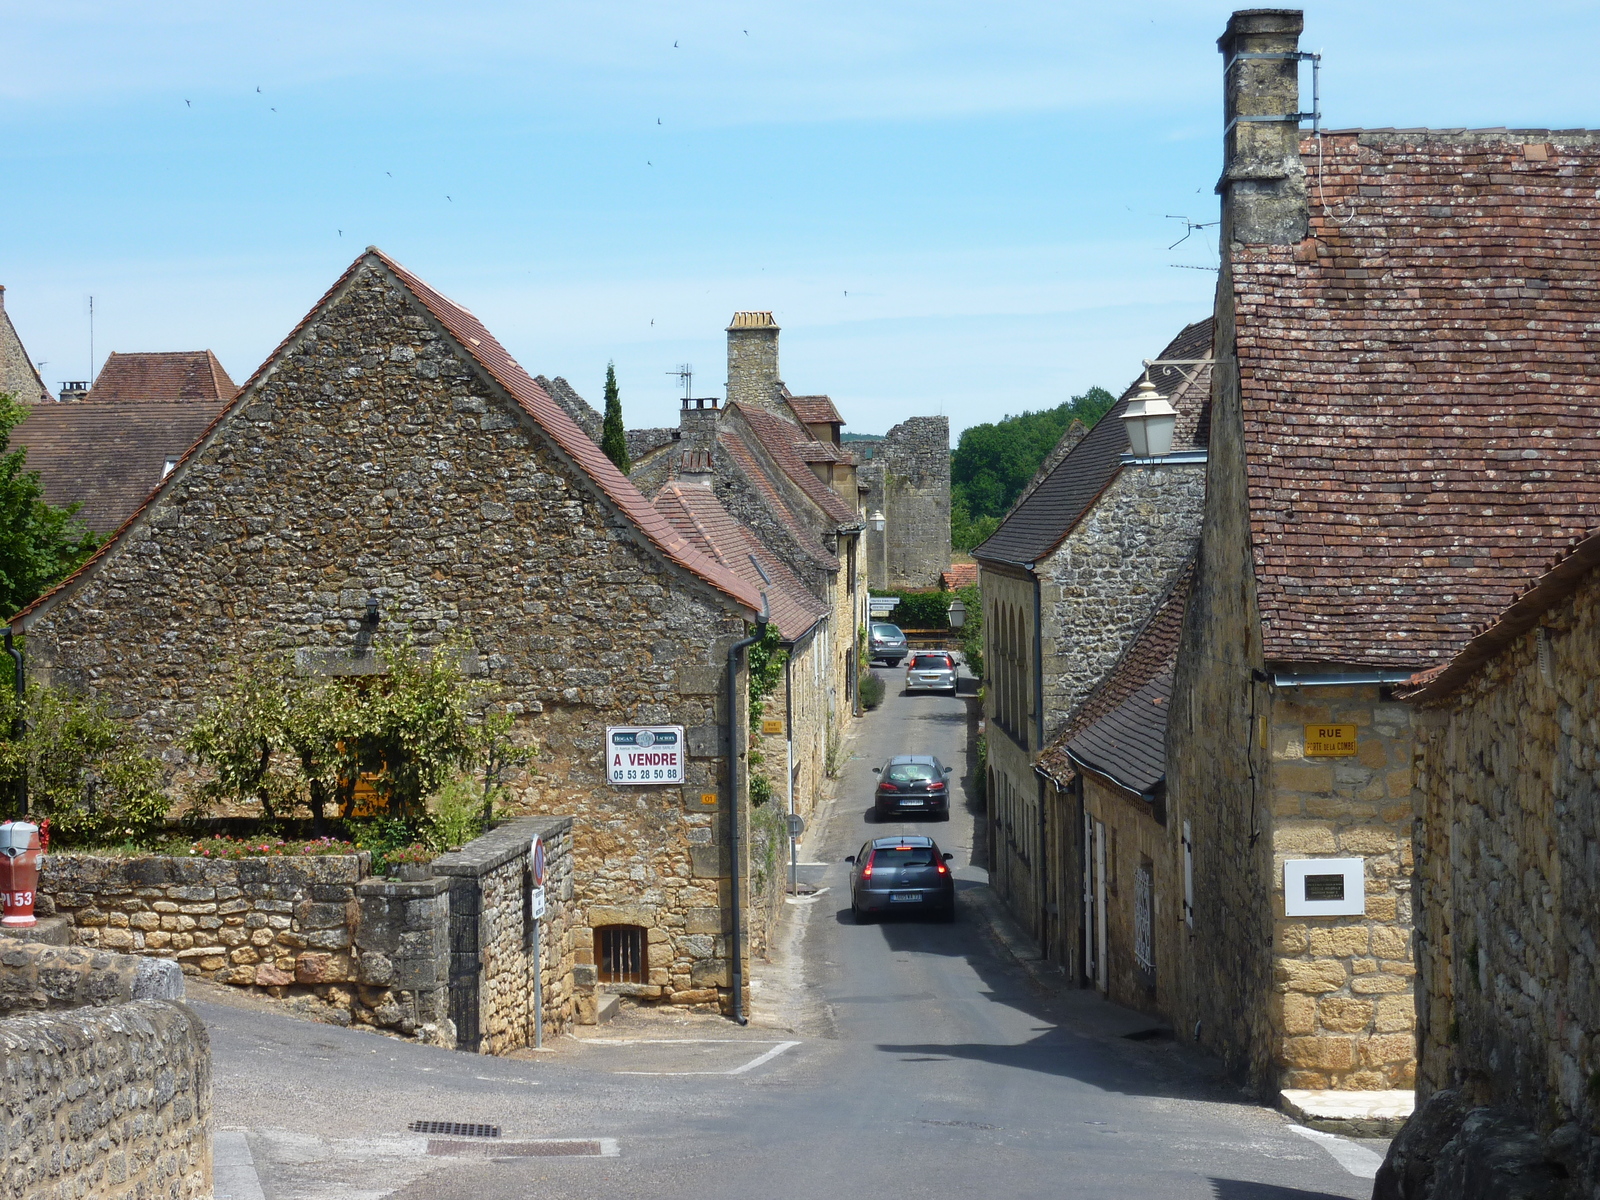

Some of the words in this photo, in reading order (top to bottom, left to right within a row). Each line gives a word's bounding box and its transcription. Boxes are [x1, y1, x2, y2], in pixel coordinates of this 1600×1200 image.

[1318, 728, 1342, 738] RUE
[613, 753, 622, 767] A
[628, 752, 677, 766] VENDRE
[613, 770, 624, 780] 05
[627, 770, 637, 780] 53
[640, 769, 650, 779] 28
[653, 769, 664, 779] 50
[667, 769, 677, 779] 88
[14, 891, 33, 907] 53
